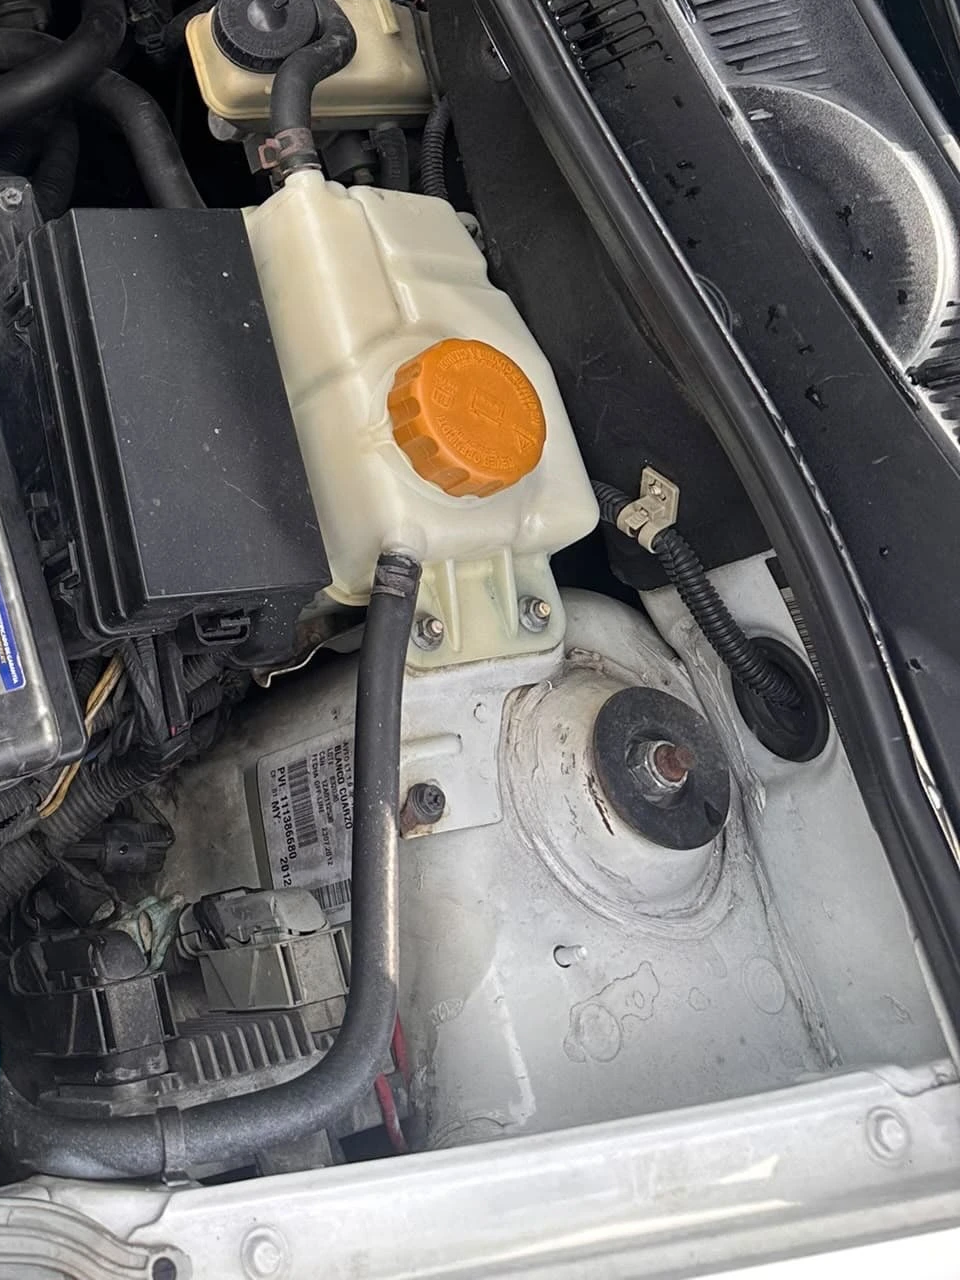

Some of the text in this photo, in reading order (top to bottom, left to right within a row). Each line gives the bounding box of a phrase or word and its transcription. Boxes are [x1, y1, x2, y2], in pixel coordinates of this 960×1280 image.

[334, 745, 353, 830] BLANCO CUARZO
[280, 795, 298, 860] 111386680
[280, 857, 292, 887] 2012
